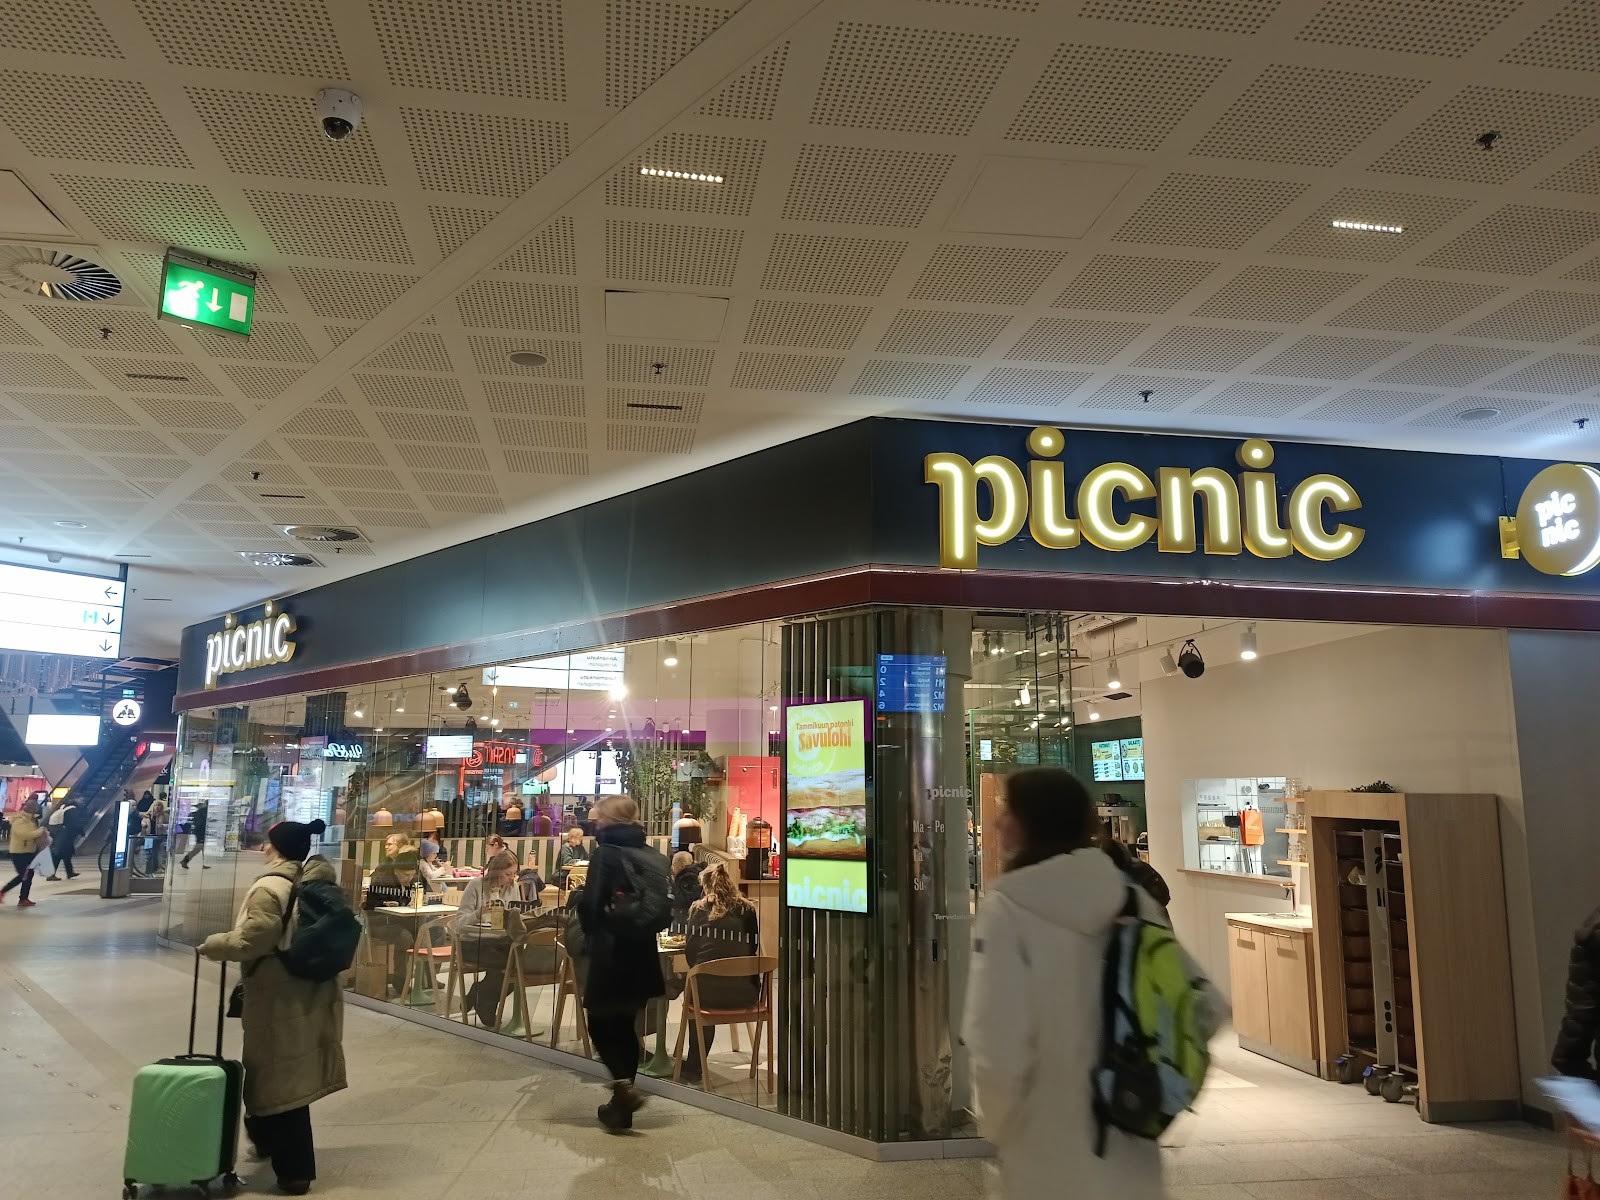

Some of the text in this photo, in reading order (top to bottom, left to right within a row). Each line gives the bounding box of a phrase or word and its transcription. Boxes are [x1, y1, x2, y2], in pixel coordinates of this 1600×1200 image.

[924, 426, 1365, 570] picnic
[1534, 491, 1576, 527] pic
[1541, 516, 1581, 548] nic
[204, 600, 297, 690] picnic
[795, 718, 854, 730] Tammikuun patonki
[798, 727, 852, 752] Savulohi
[931, 785, 973, 801] picnic
[913, 820, 925, 833] Ma
[934, 820, 945, 833] Pe
[914, 878, 925, 891] Su
